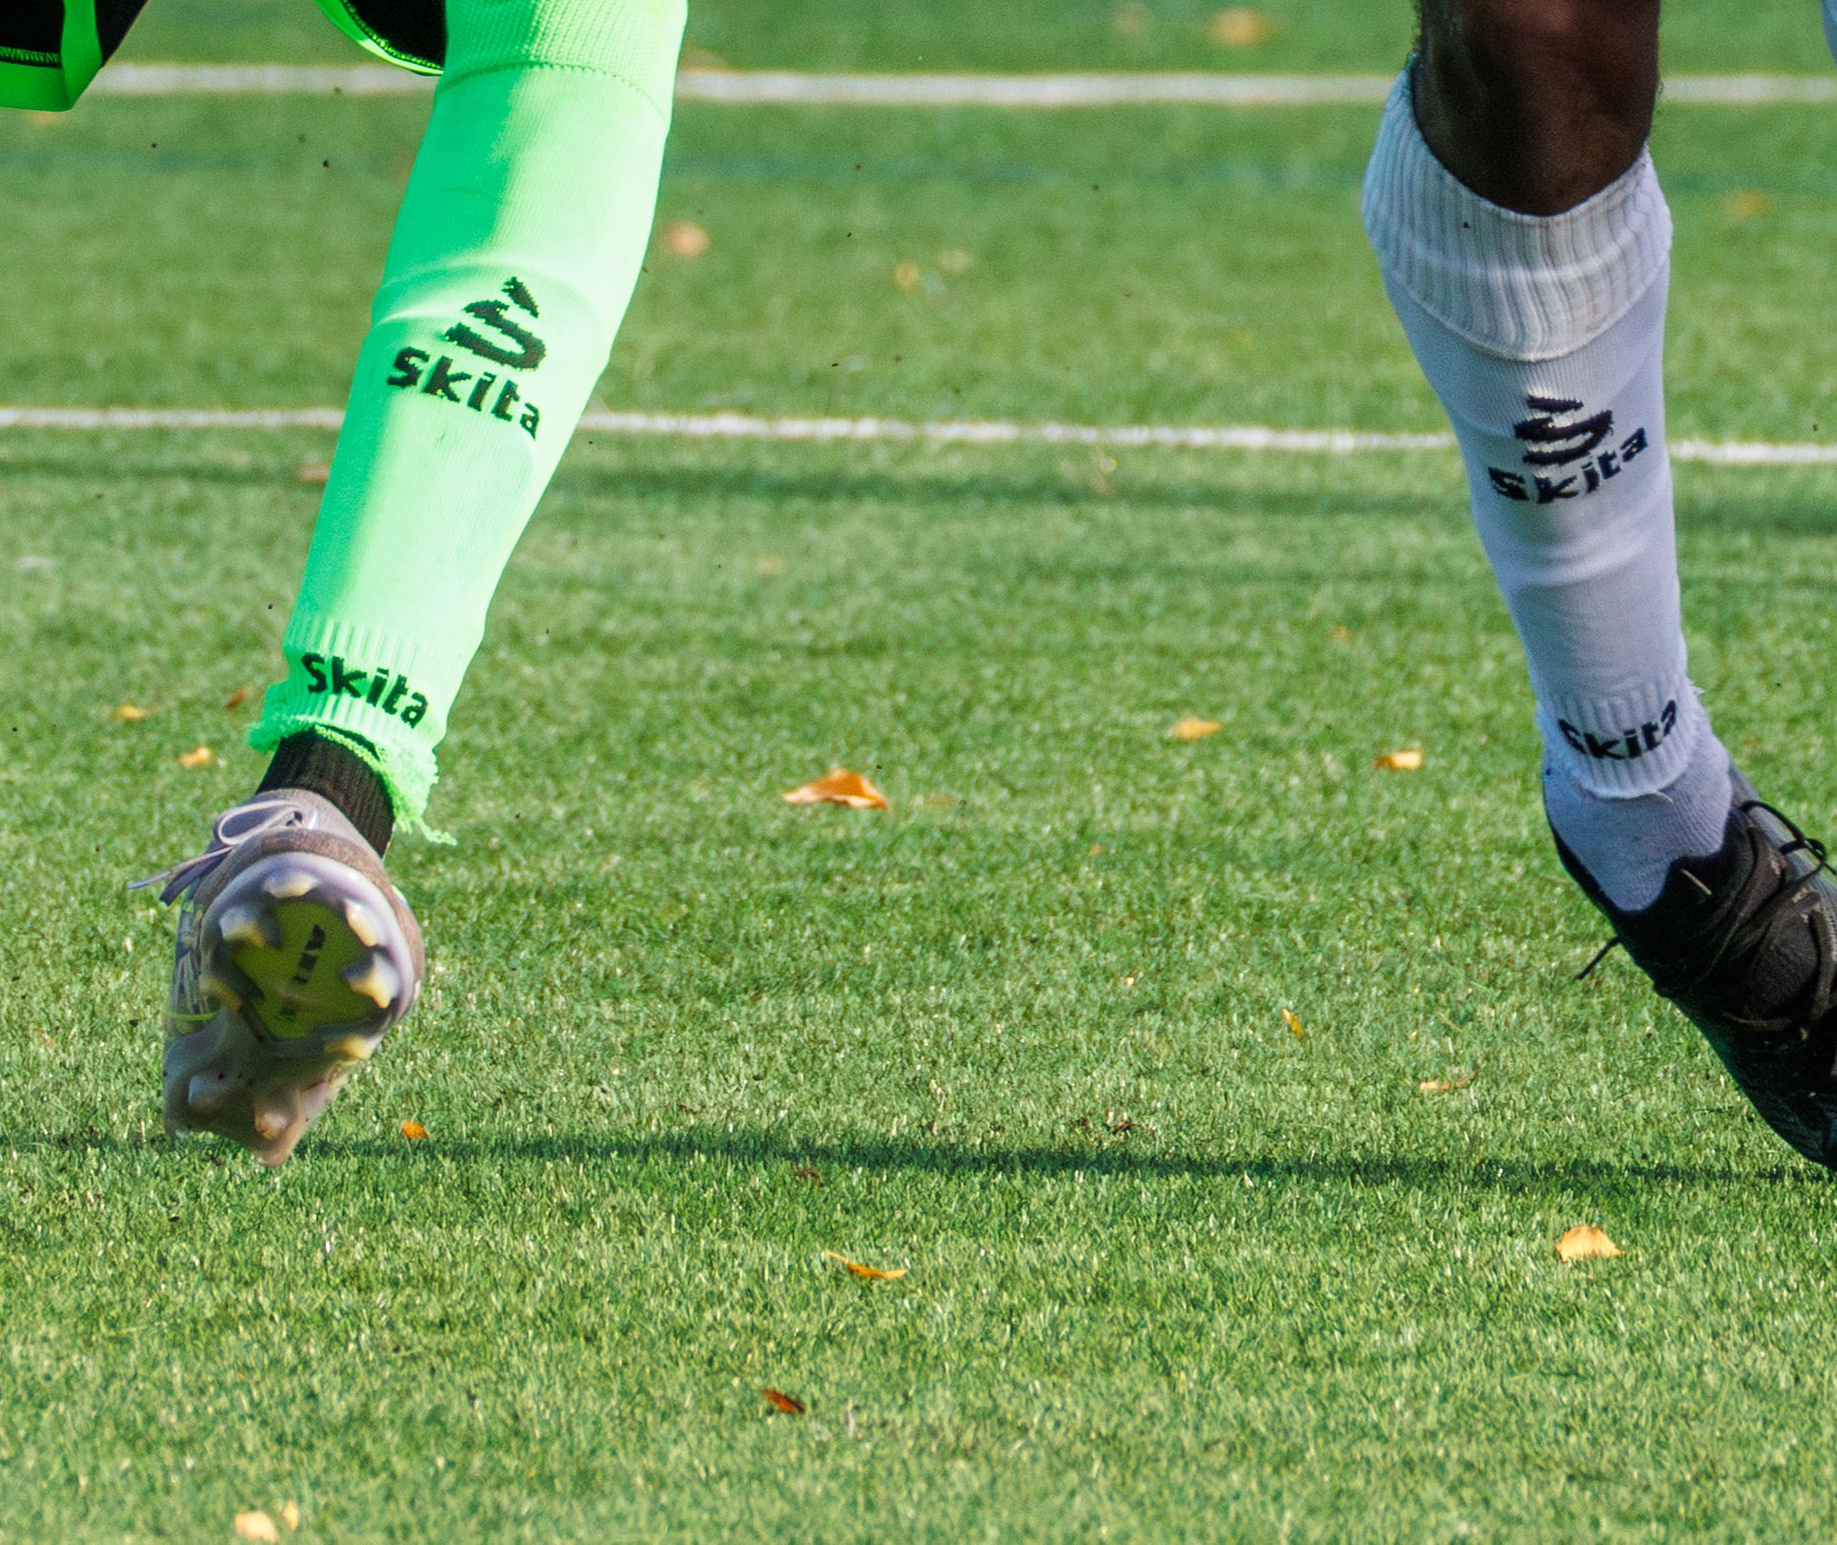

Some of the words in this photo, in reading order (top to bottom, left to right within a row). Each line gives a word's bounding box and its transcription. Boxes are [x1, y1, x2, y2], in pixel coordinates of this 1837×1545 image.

[386, 346, 540, 440] Skita
[1488, 426, 1648, 505] Skita
[300, 652, 429, 730] Skita
